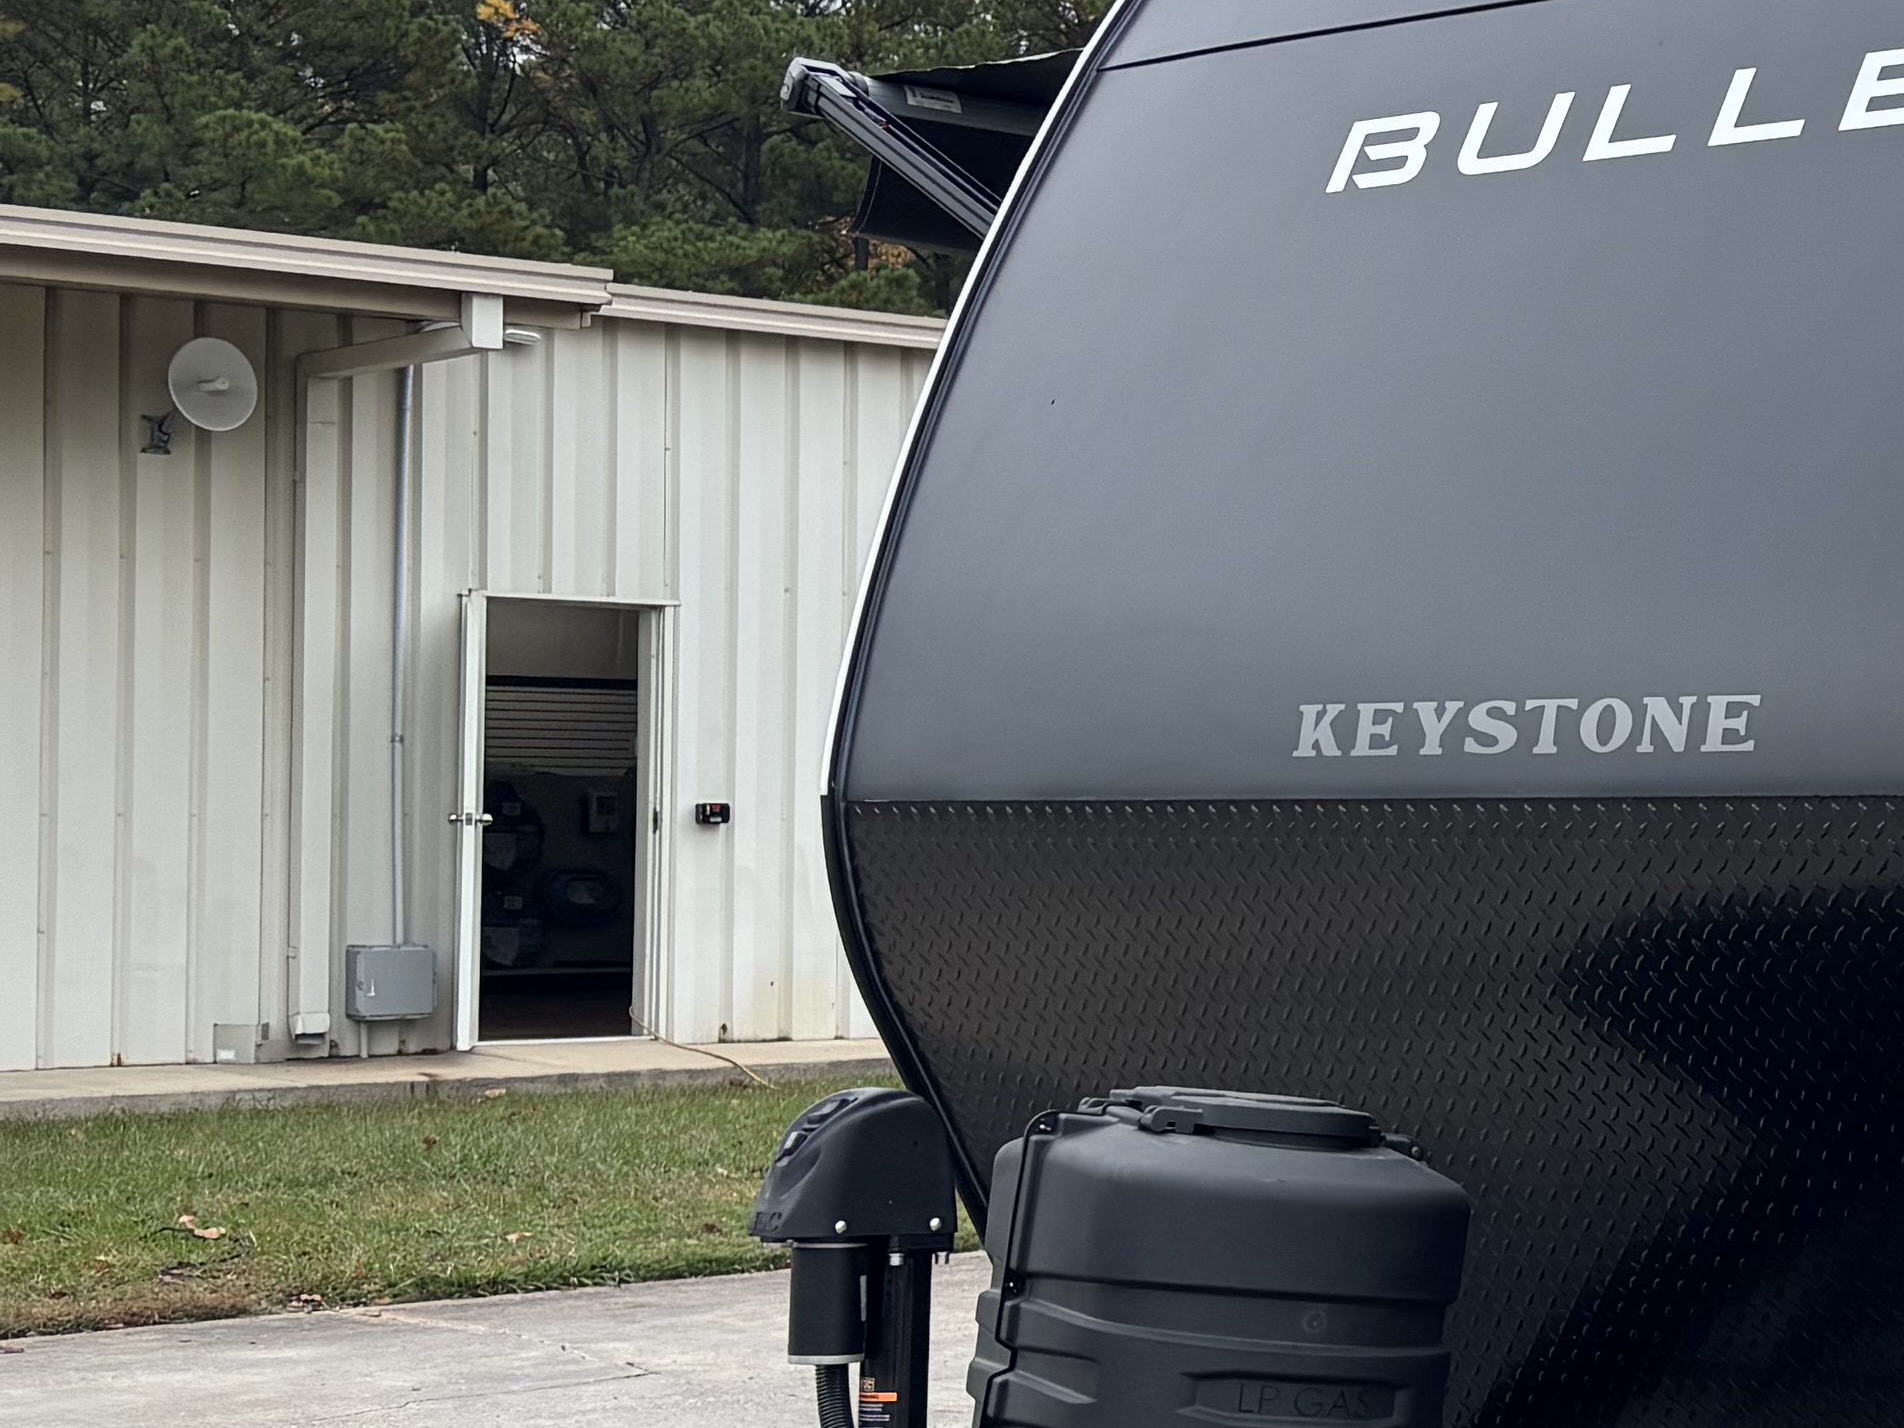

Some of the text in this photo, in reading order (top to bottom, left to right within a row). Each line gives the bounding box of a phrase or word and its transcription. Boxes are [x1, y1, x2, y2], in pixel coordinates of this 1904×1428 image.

[1291, 693, 1762, 757] KEYSTONE
[1238, 1383, 1371, 1420] LP GAS
